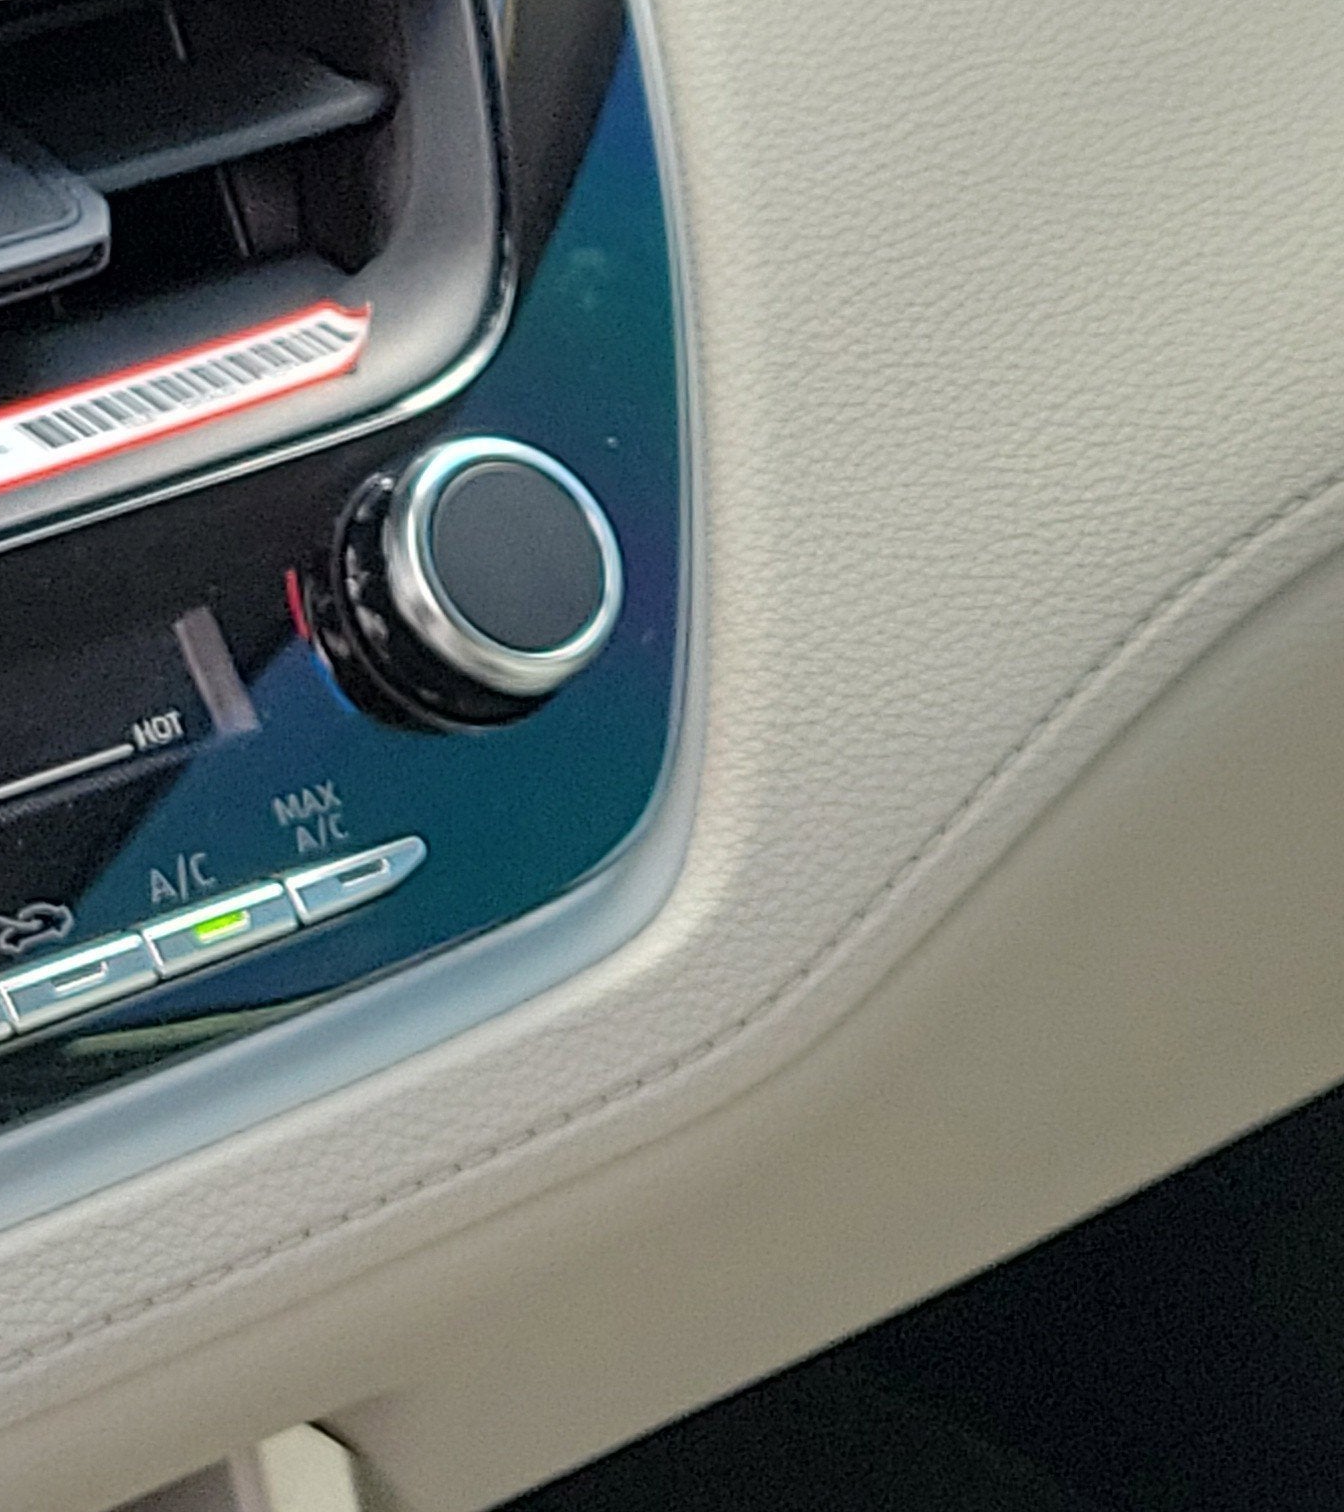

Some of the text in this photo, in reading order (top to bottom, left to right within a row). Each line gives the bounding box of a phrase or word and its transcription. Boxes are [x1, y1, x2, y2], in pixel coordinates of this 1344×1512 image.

[132, 709, 185, 751] HOT
[272, 778, 342, 827] MAX
[295, 812, 350, 854] A/C
[149, 851, 218, 905] A/C
